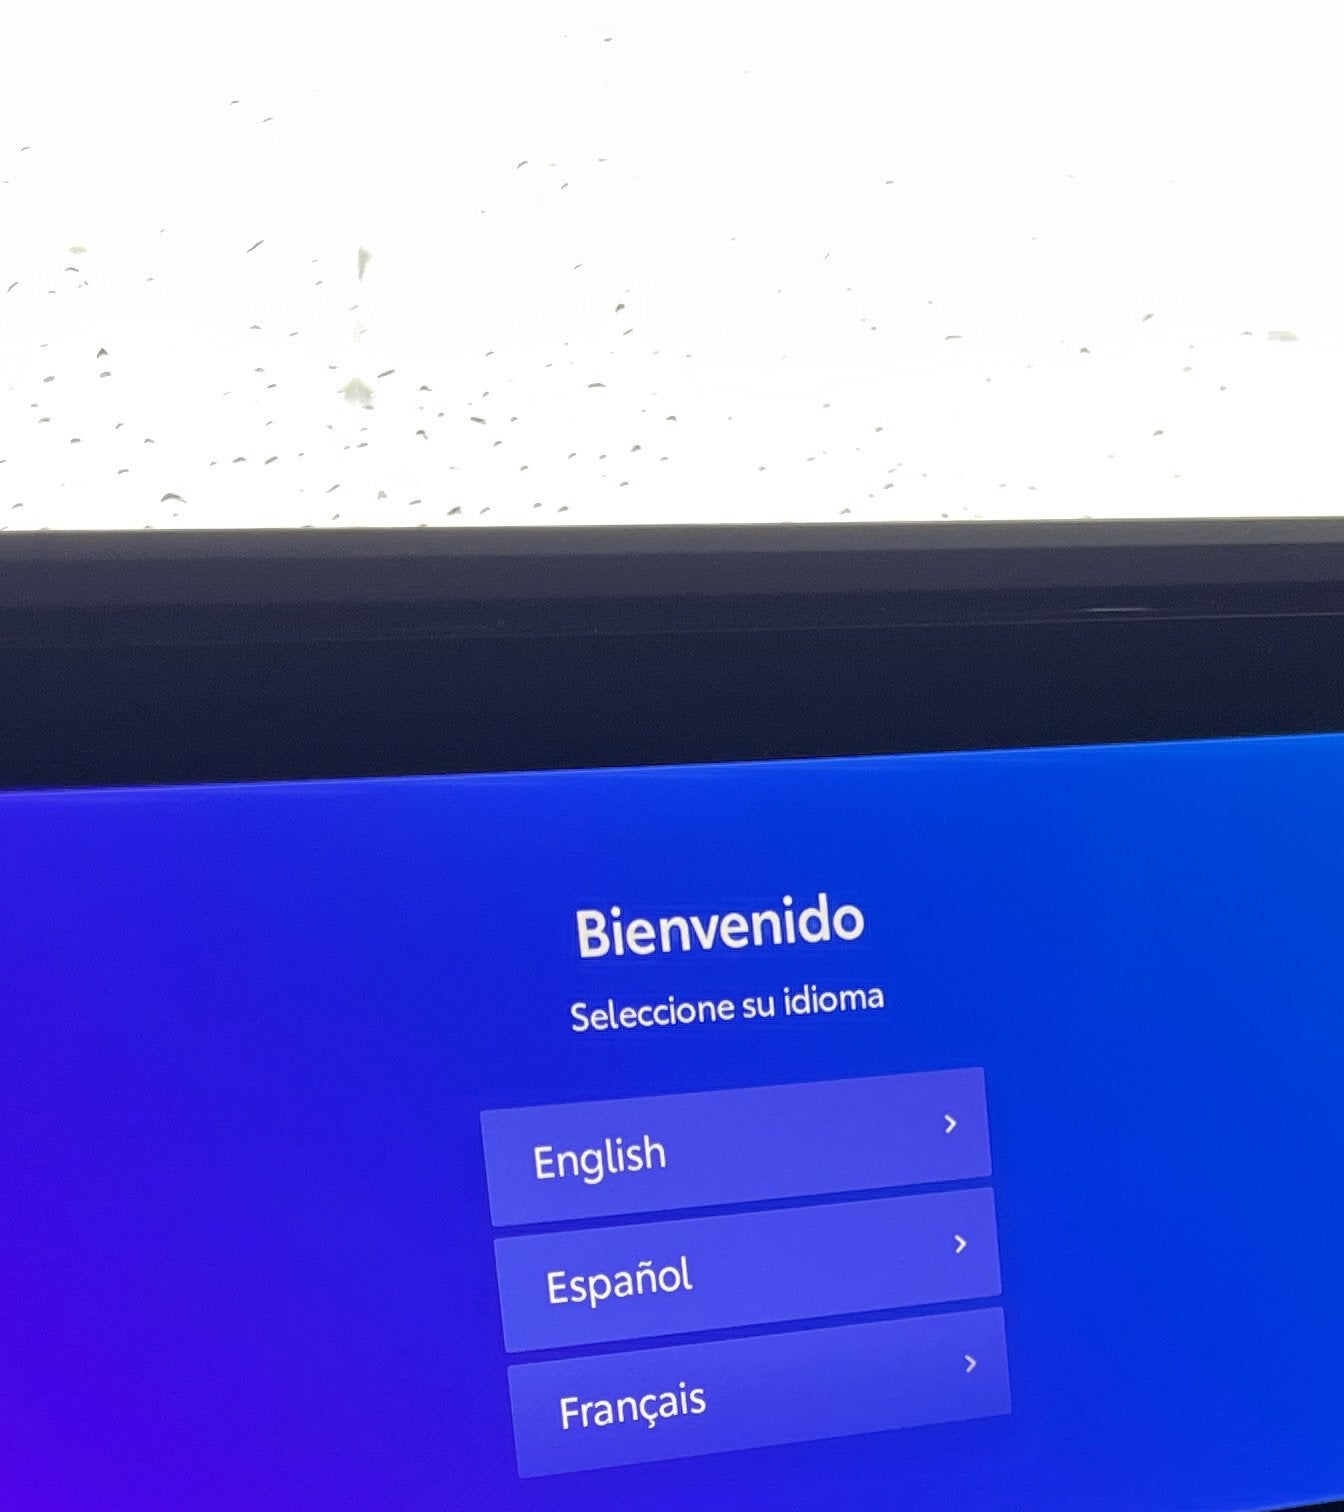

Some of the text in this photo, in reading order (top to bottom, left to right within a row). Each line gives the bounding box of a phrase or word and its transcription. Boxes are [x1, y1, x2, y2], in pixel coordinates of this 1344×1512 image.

[576, 892, 865, 960] Bienvenido
[570, 983, 886, 1032] Seleccione su idioma
[532, 1134, 667, 1185] English
[546, 1255, 694, 1309] Español
[559, 1380, 708, 1430] Français
